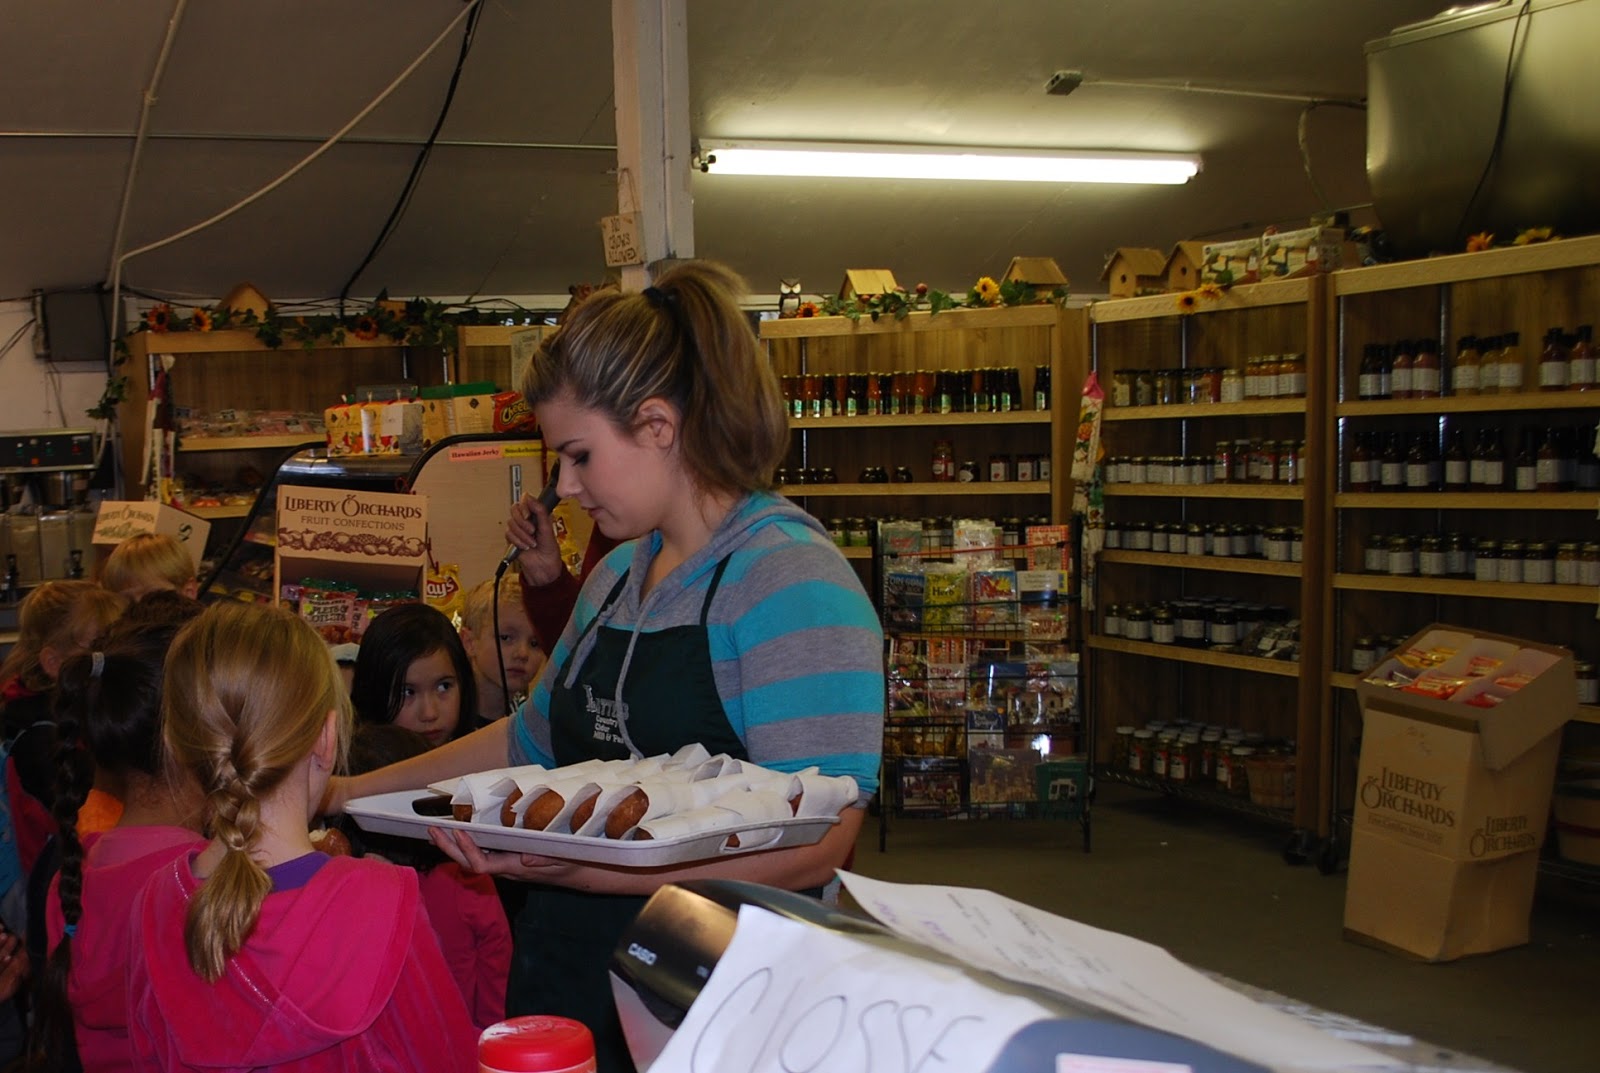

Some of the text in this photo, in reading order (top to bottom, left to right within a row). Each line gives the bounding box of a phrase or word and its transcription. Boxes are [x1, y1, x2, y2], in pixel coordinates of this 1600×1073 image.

[285, 495, 423, 520] LIBERTY ORCHARDS
[301, 515, 406, 532] FRUIT CONFECTIONS
[1382, 767, 1447, 801] LIBERTY
[1361, 776, 1455, 828] ORCHARDS
[627, 942, 658, 966] CASIO
